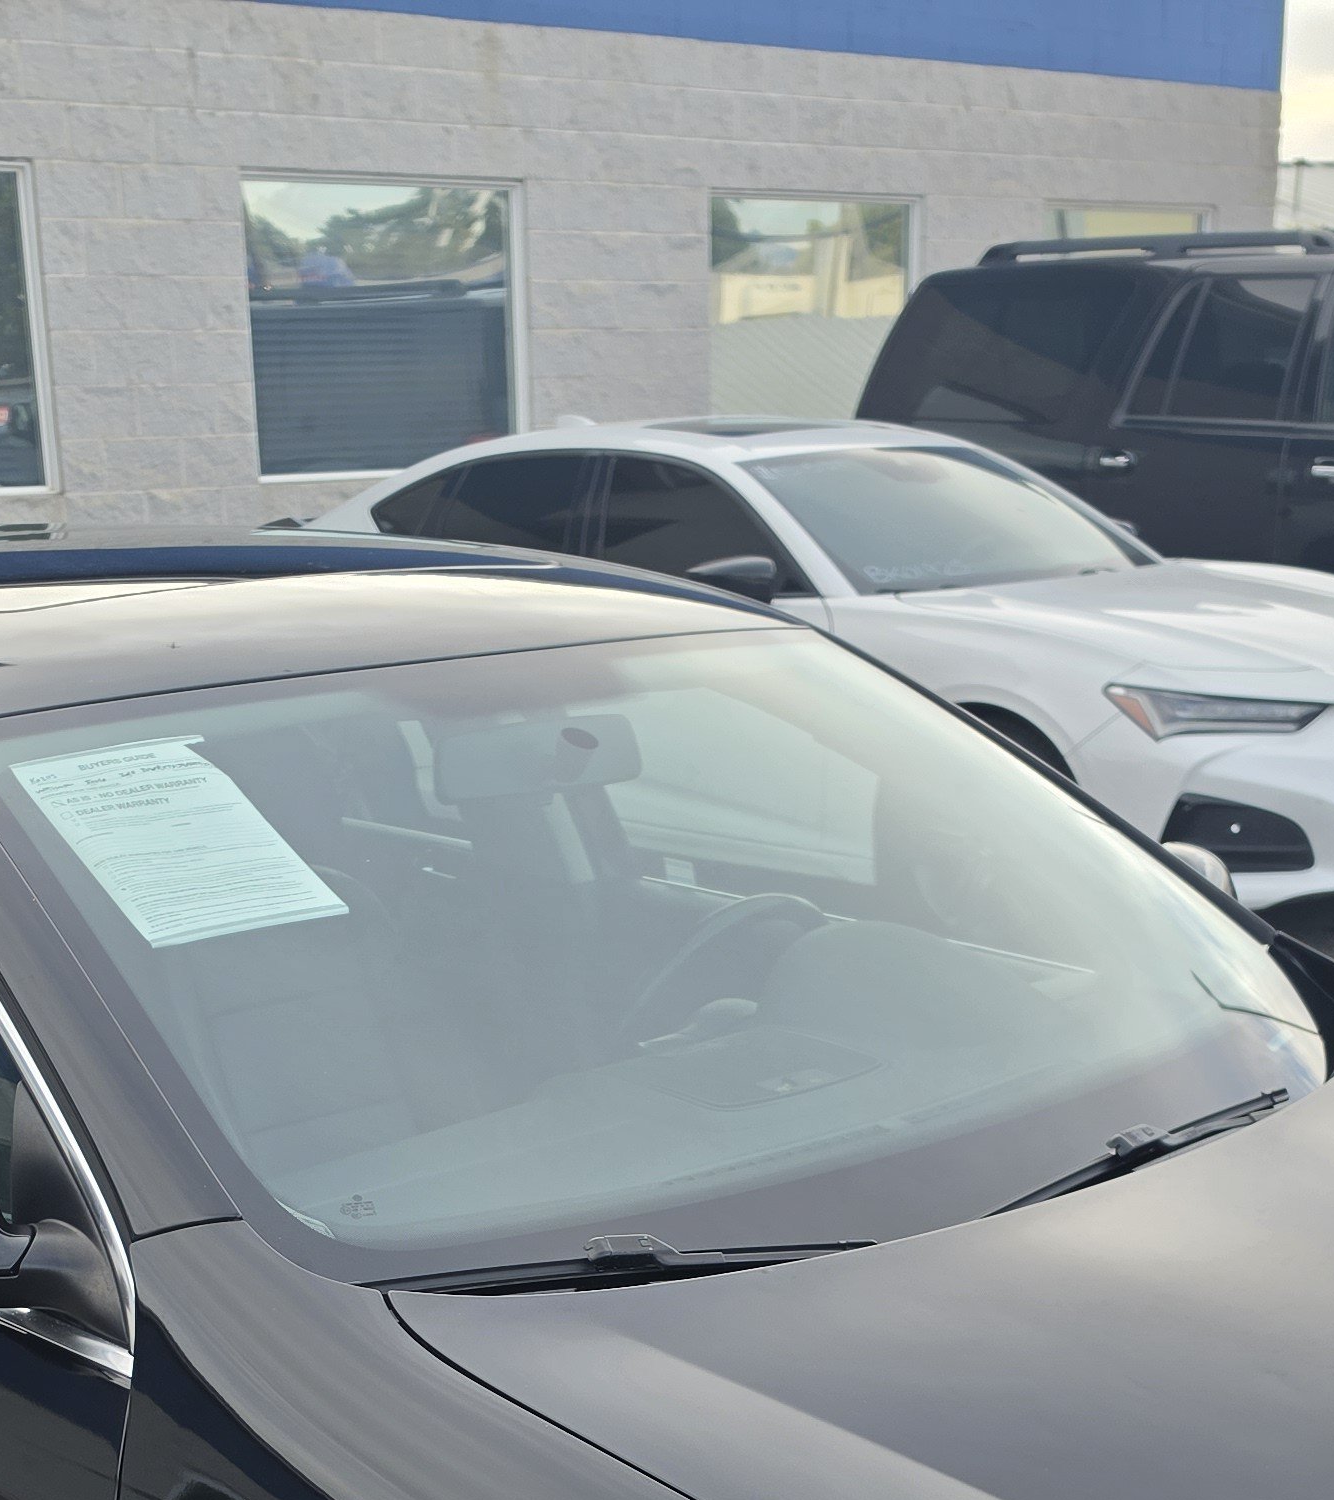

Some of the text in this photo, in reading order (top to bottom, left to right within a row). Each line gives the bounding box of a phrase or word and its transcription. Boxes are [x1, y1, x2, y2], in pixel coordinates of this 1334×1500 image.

[77, 752, 157, 772] BUYERS GUIDE
[66, 795, 82, 804] AS
[82, 794, 92, 802] IS
[99, 790, 115, 799] NO
[115, 783, 153, 796] DEALER
[154, 776, 208, 791] WARRANTY
[75, 797, 171, 817] DEALER WARRANTY
